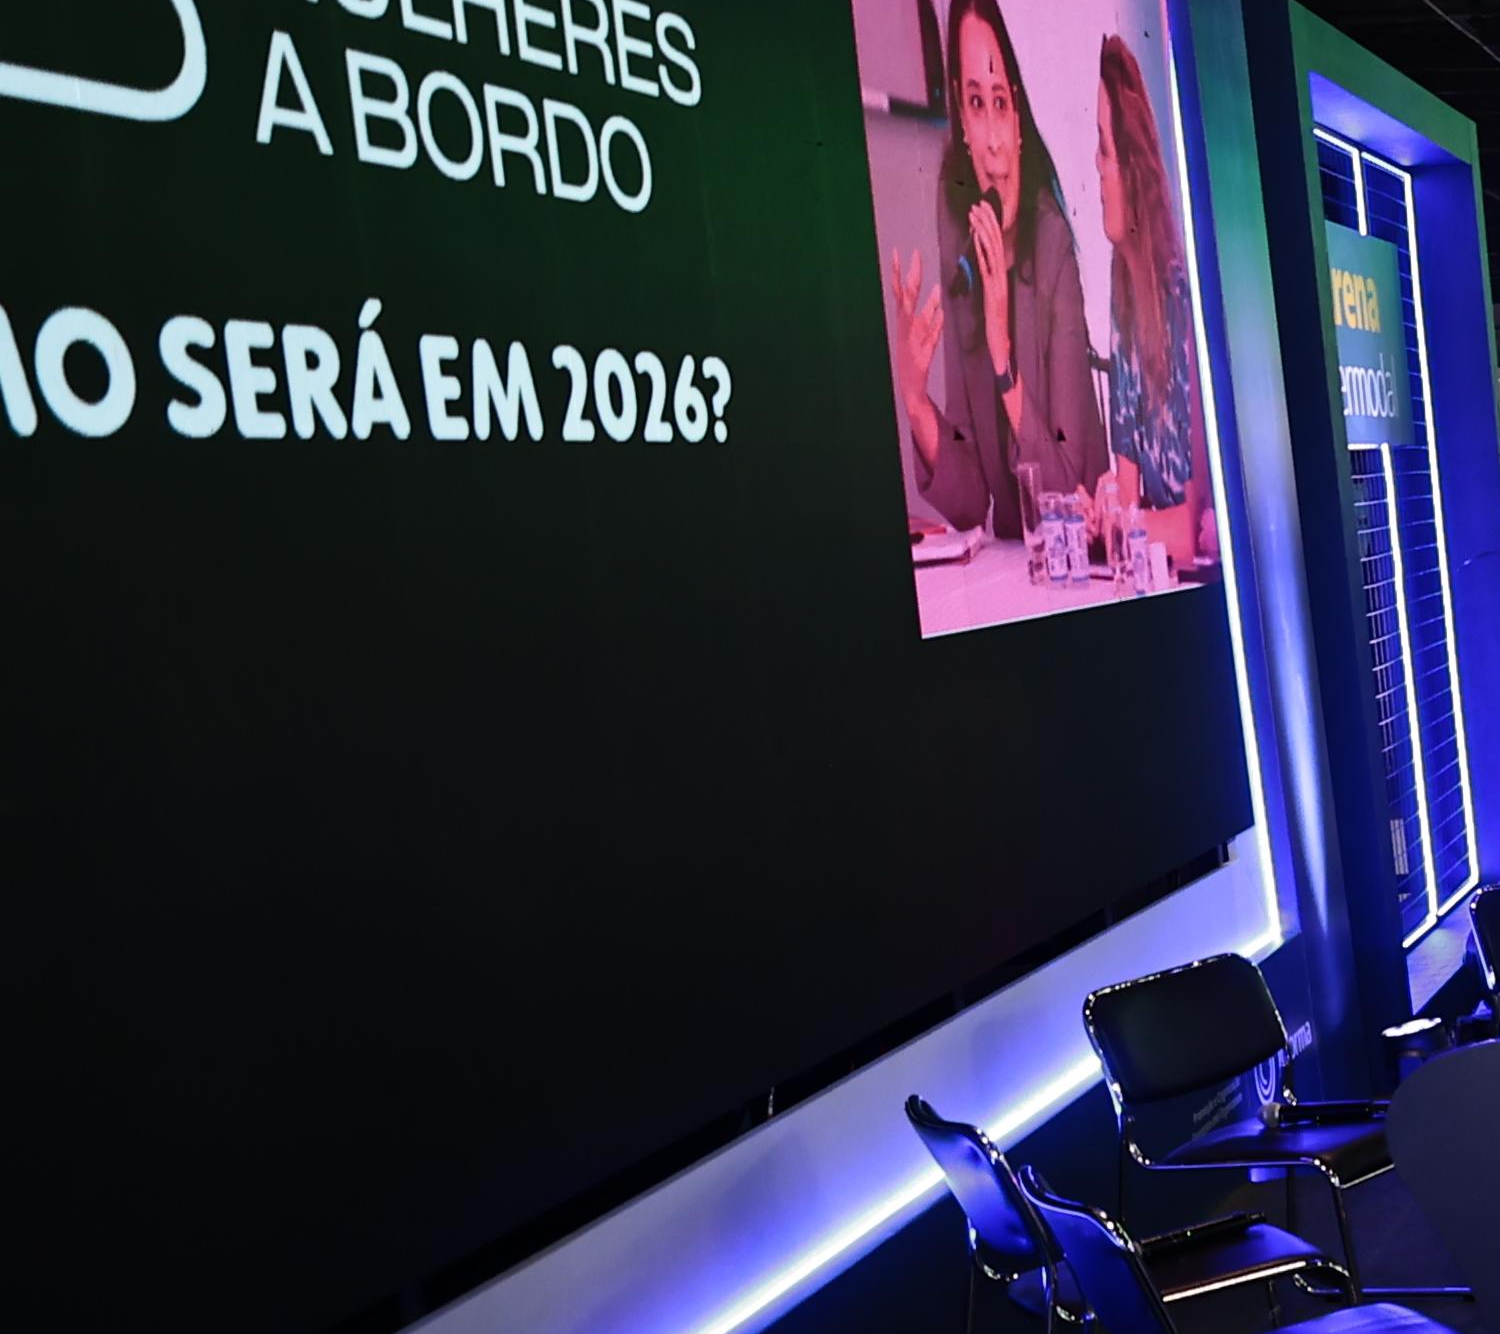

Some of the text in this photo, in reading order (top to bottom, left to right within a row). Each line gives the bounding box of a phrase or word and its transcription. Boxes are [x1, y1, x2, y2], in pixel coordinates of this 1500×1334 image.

[256, 29, 652, 214] A BORDO
[158, 297, 411, 440] SERÁ
[419, 334, 544, 442] EM
[551, 344, 732, 444] 2026?
[1331, 267, 1381, 334] rena
